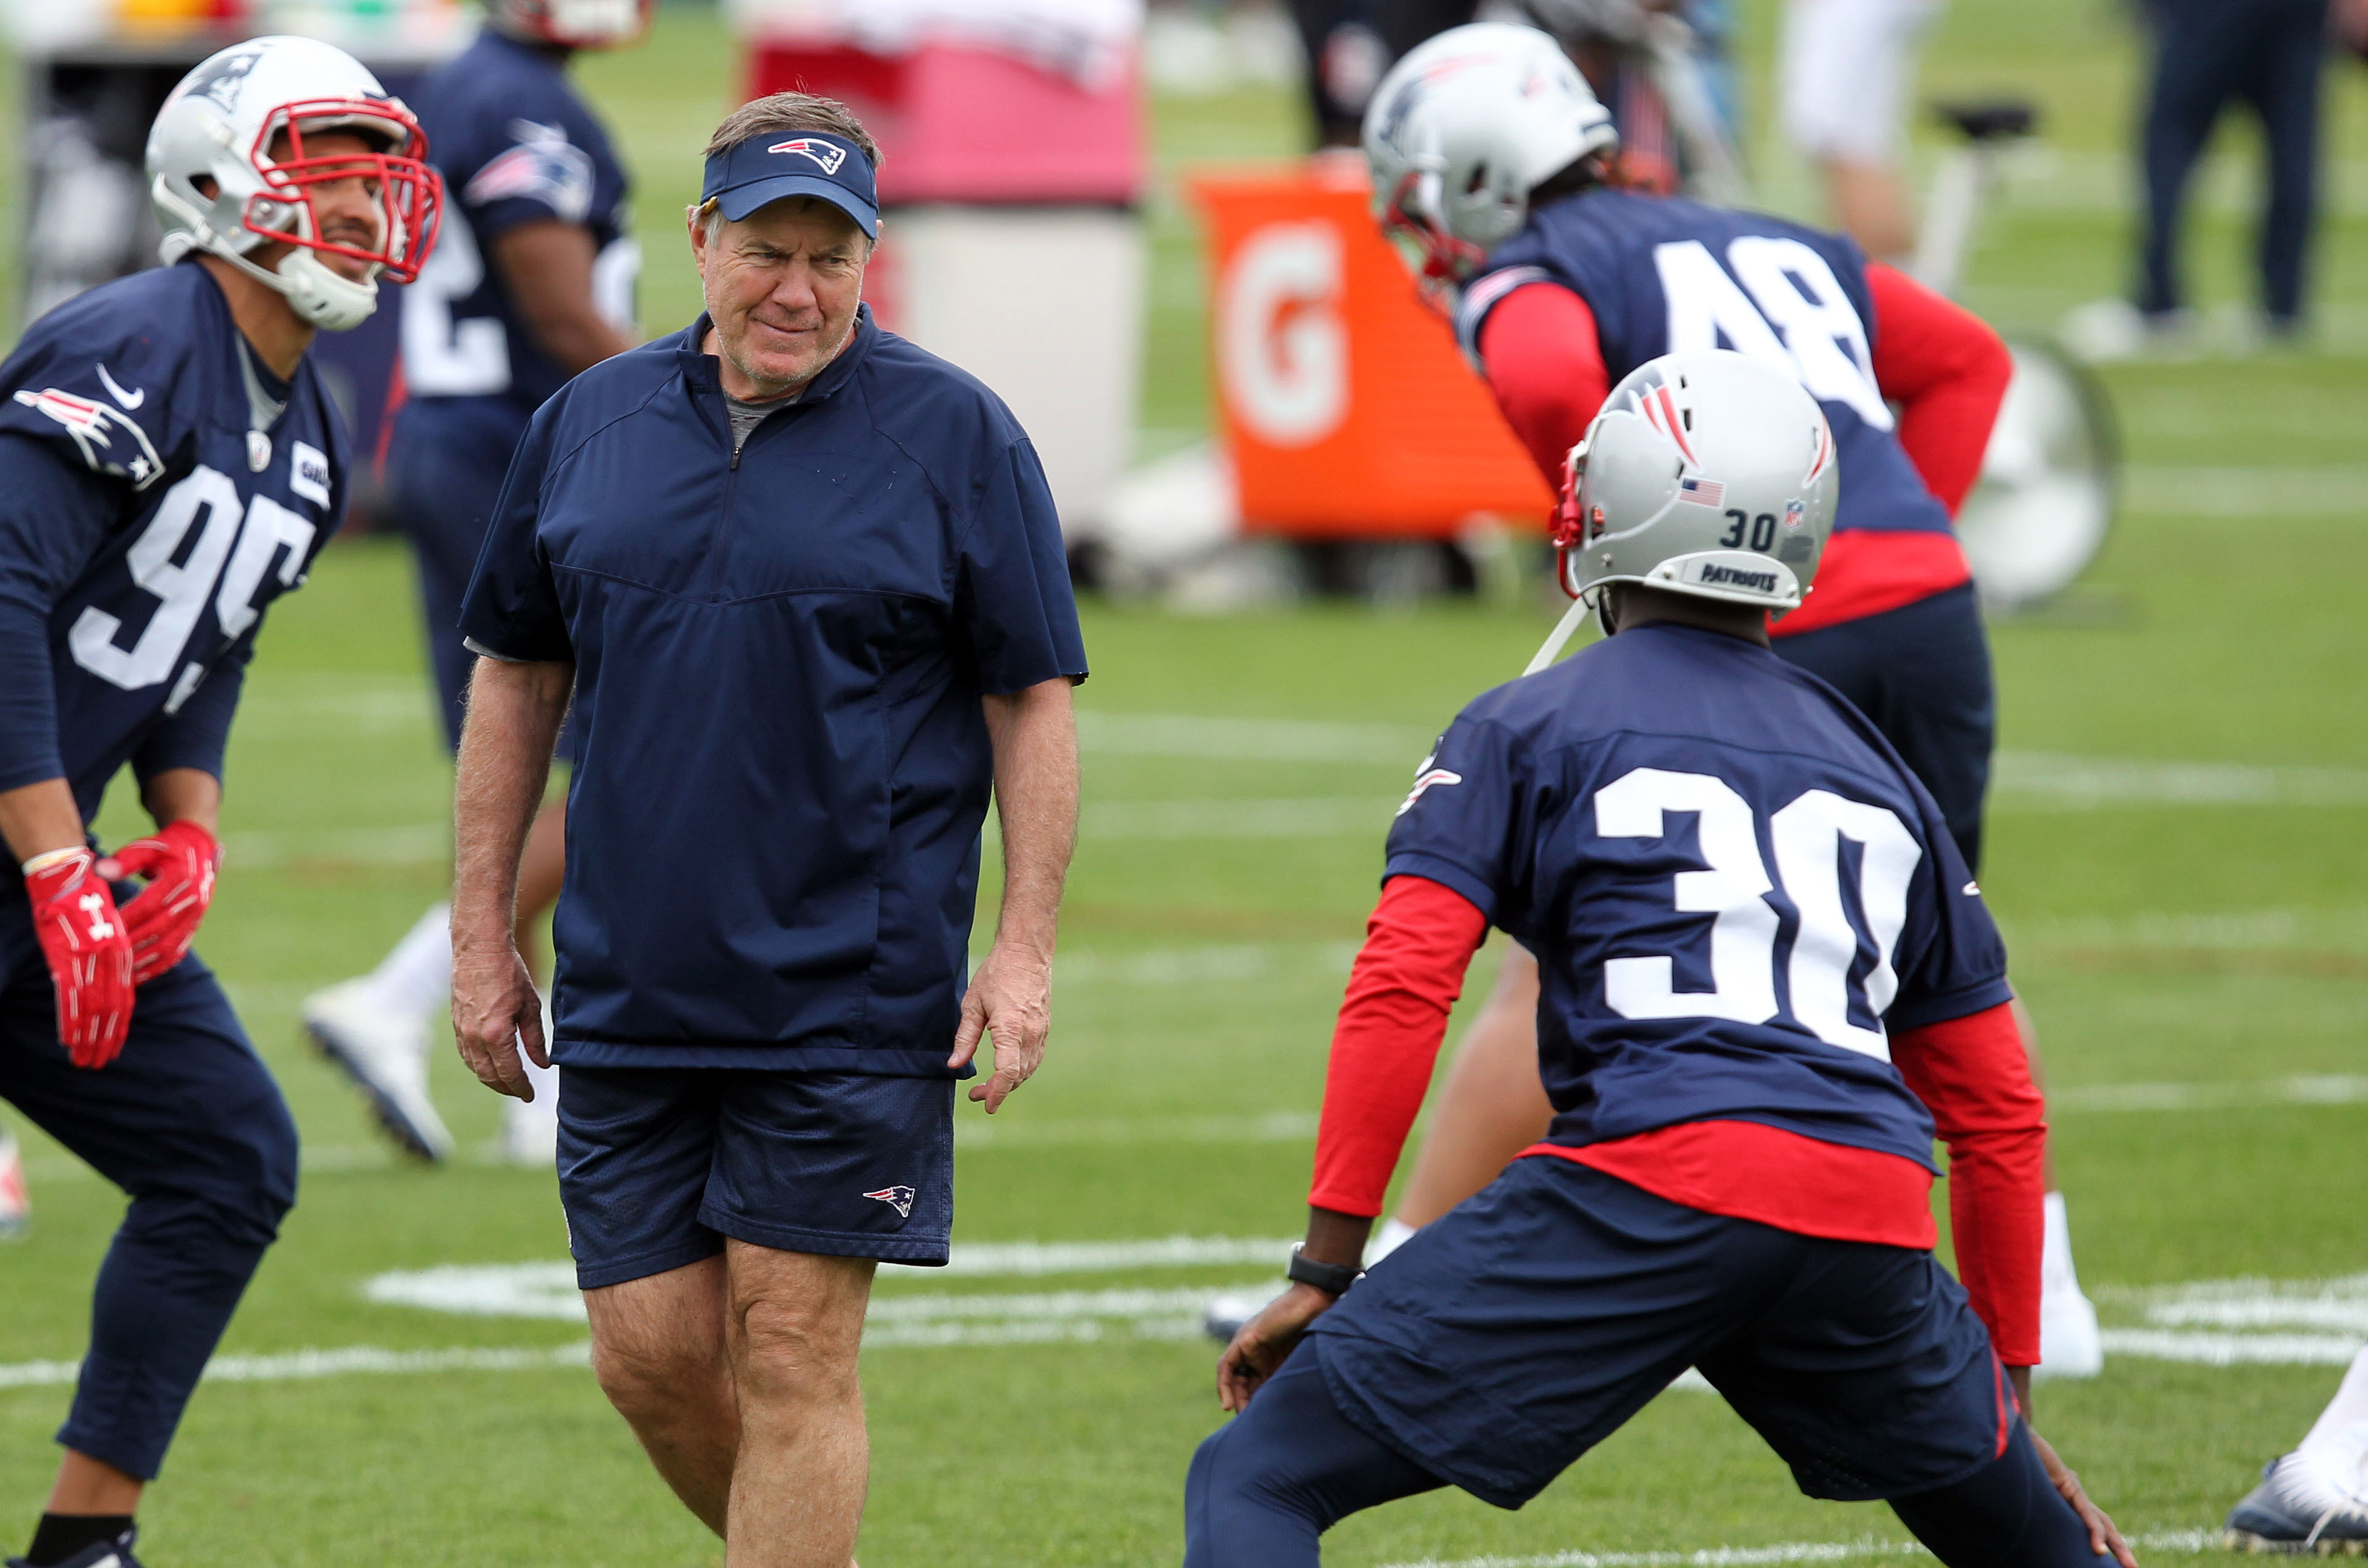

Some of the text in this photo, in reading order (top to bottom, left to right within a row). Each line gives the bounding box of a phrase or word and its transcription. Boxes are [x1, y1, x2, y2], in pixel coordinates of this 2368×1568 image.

[1219, 220, 1351, 447] G
[1653, 235, 1895, 432] 48
[68, 464, 317, 715] 95
[1701, 563, 1779, 592] PATRIOTS
[1719, 509, 1777, 552] 30
[1594, 767, 1922, 1064] 30
